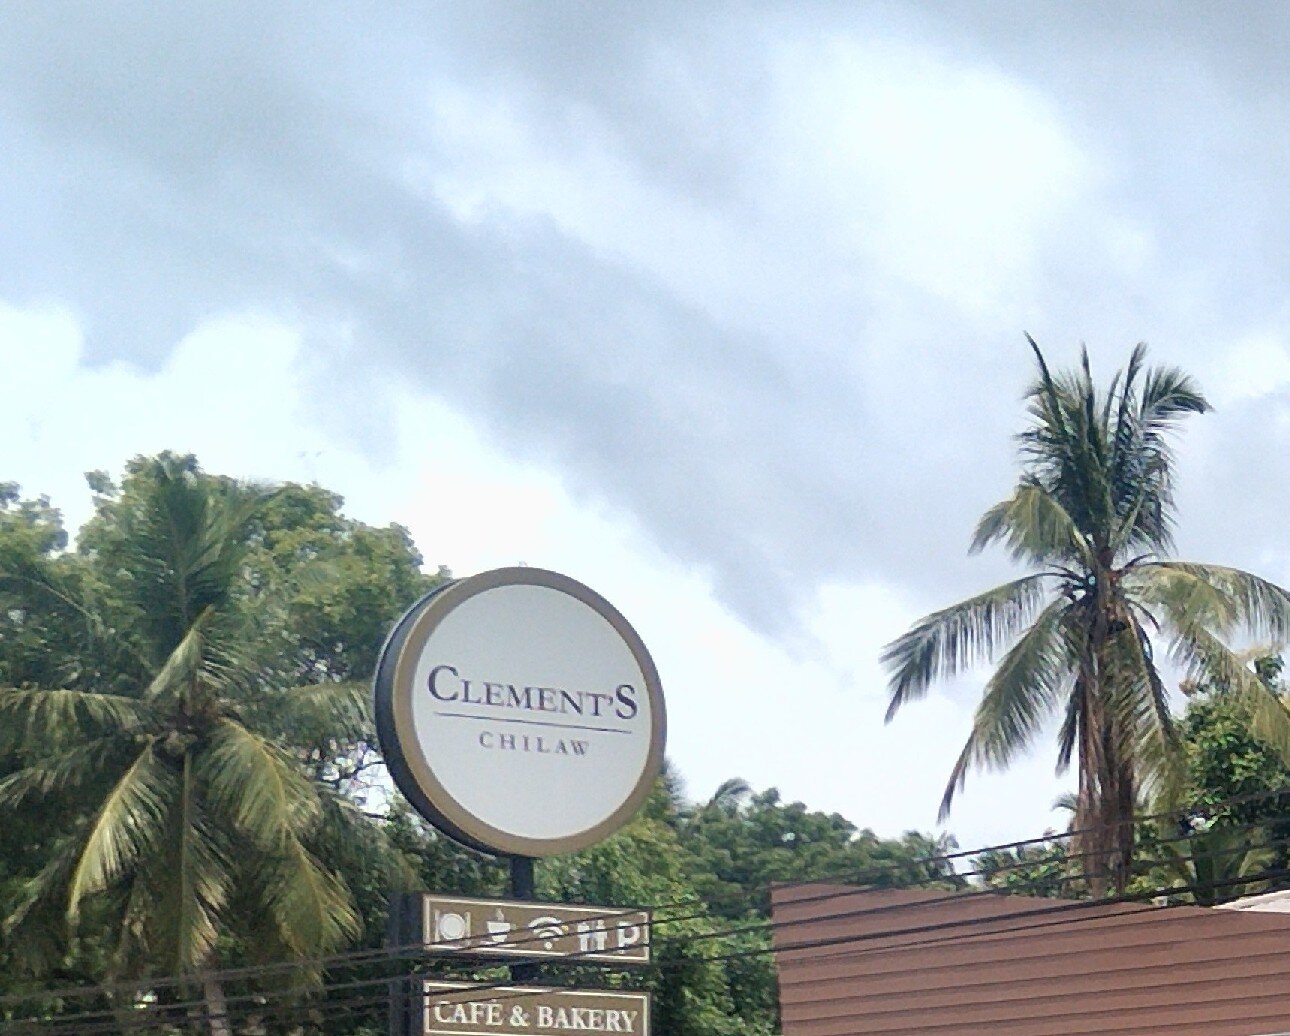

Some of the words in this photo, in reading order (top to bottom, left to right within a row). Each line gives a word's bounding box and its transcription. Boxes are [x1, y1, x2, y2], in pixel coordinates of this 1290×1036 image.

[478, 731, 588, 755] CHILAW
[509, 1004, 530, 1027] &
[537, 1006, 637, 1032] BAKERY
